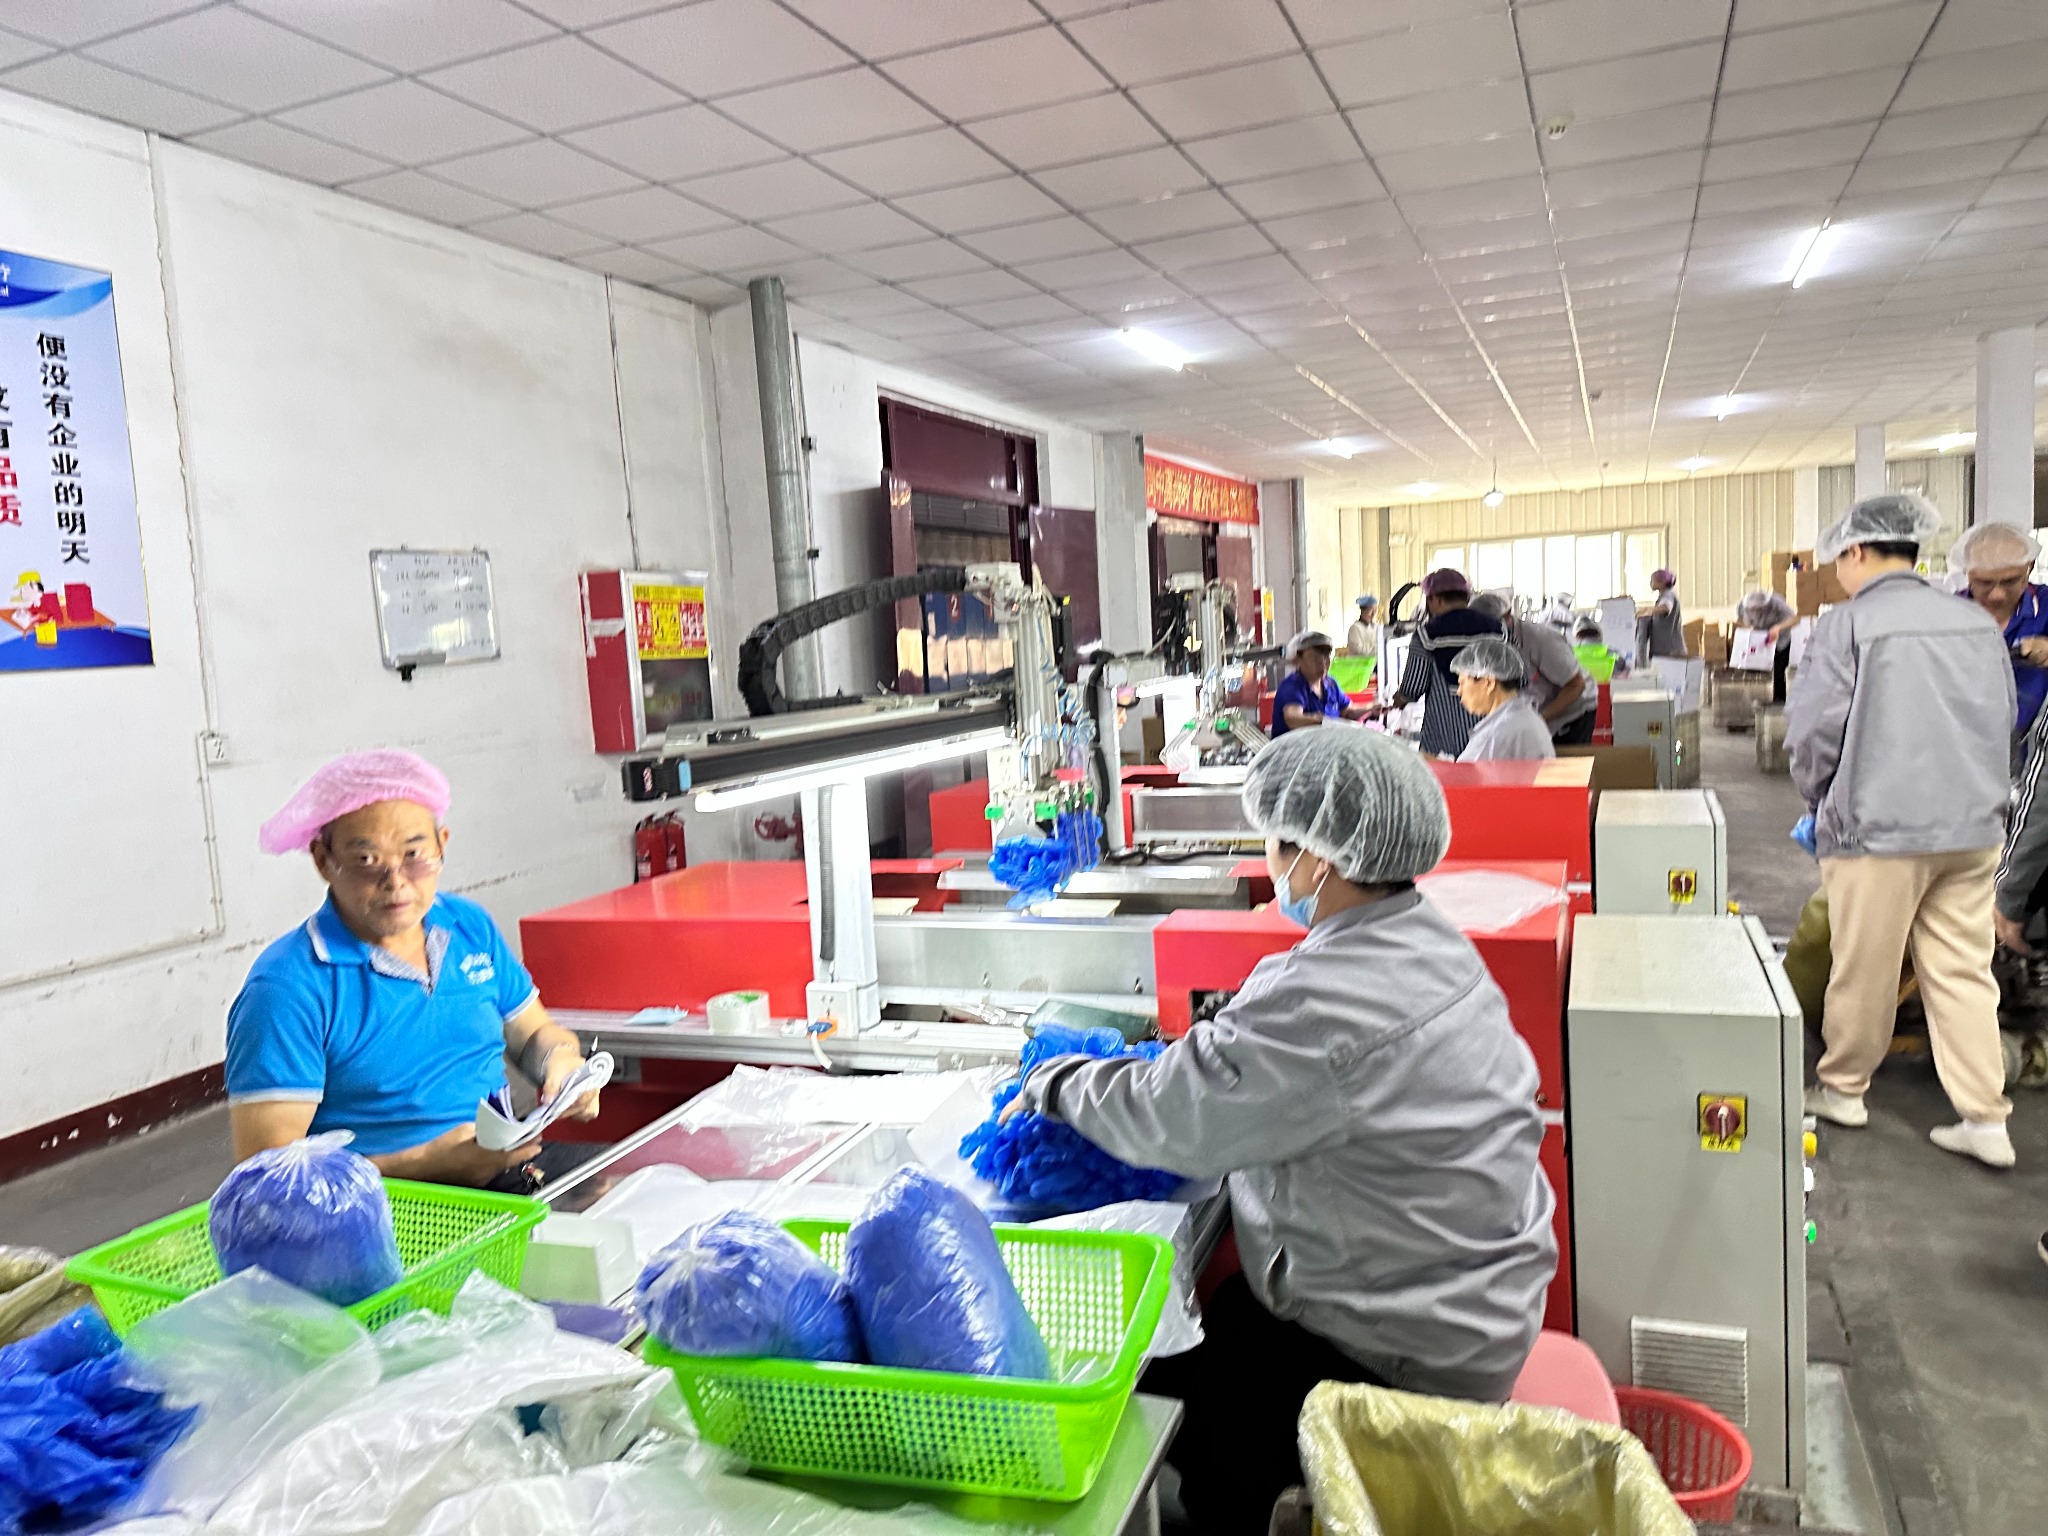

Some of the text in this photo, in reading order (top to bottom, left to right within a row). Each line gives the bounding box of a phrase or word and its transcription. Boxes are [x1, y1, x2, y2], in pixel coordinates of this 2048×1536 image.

[37, 331, 90, 565] 便没有企业的明天
